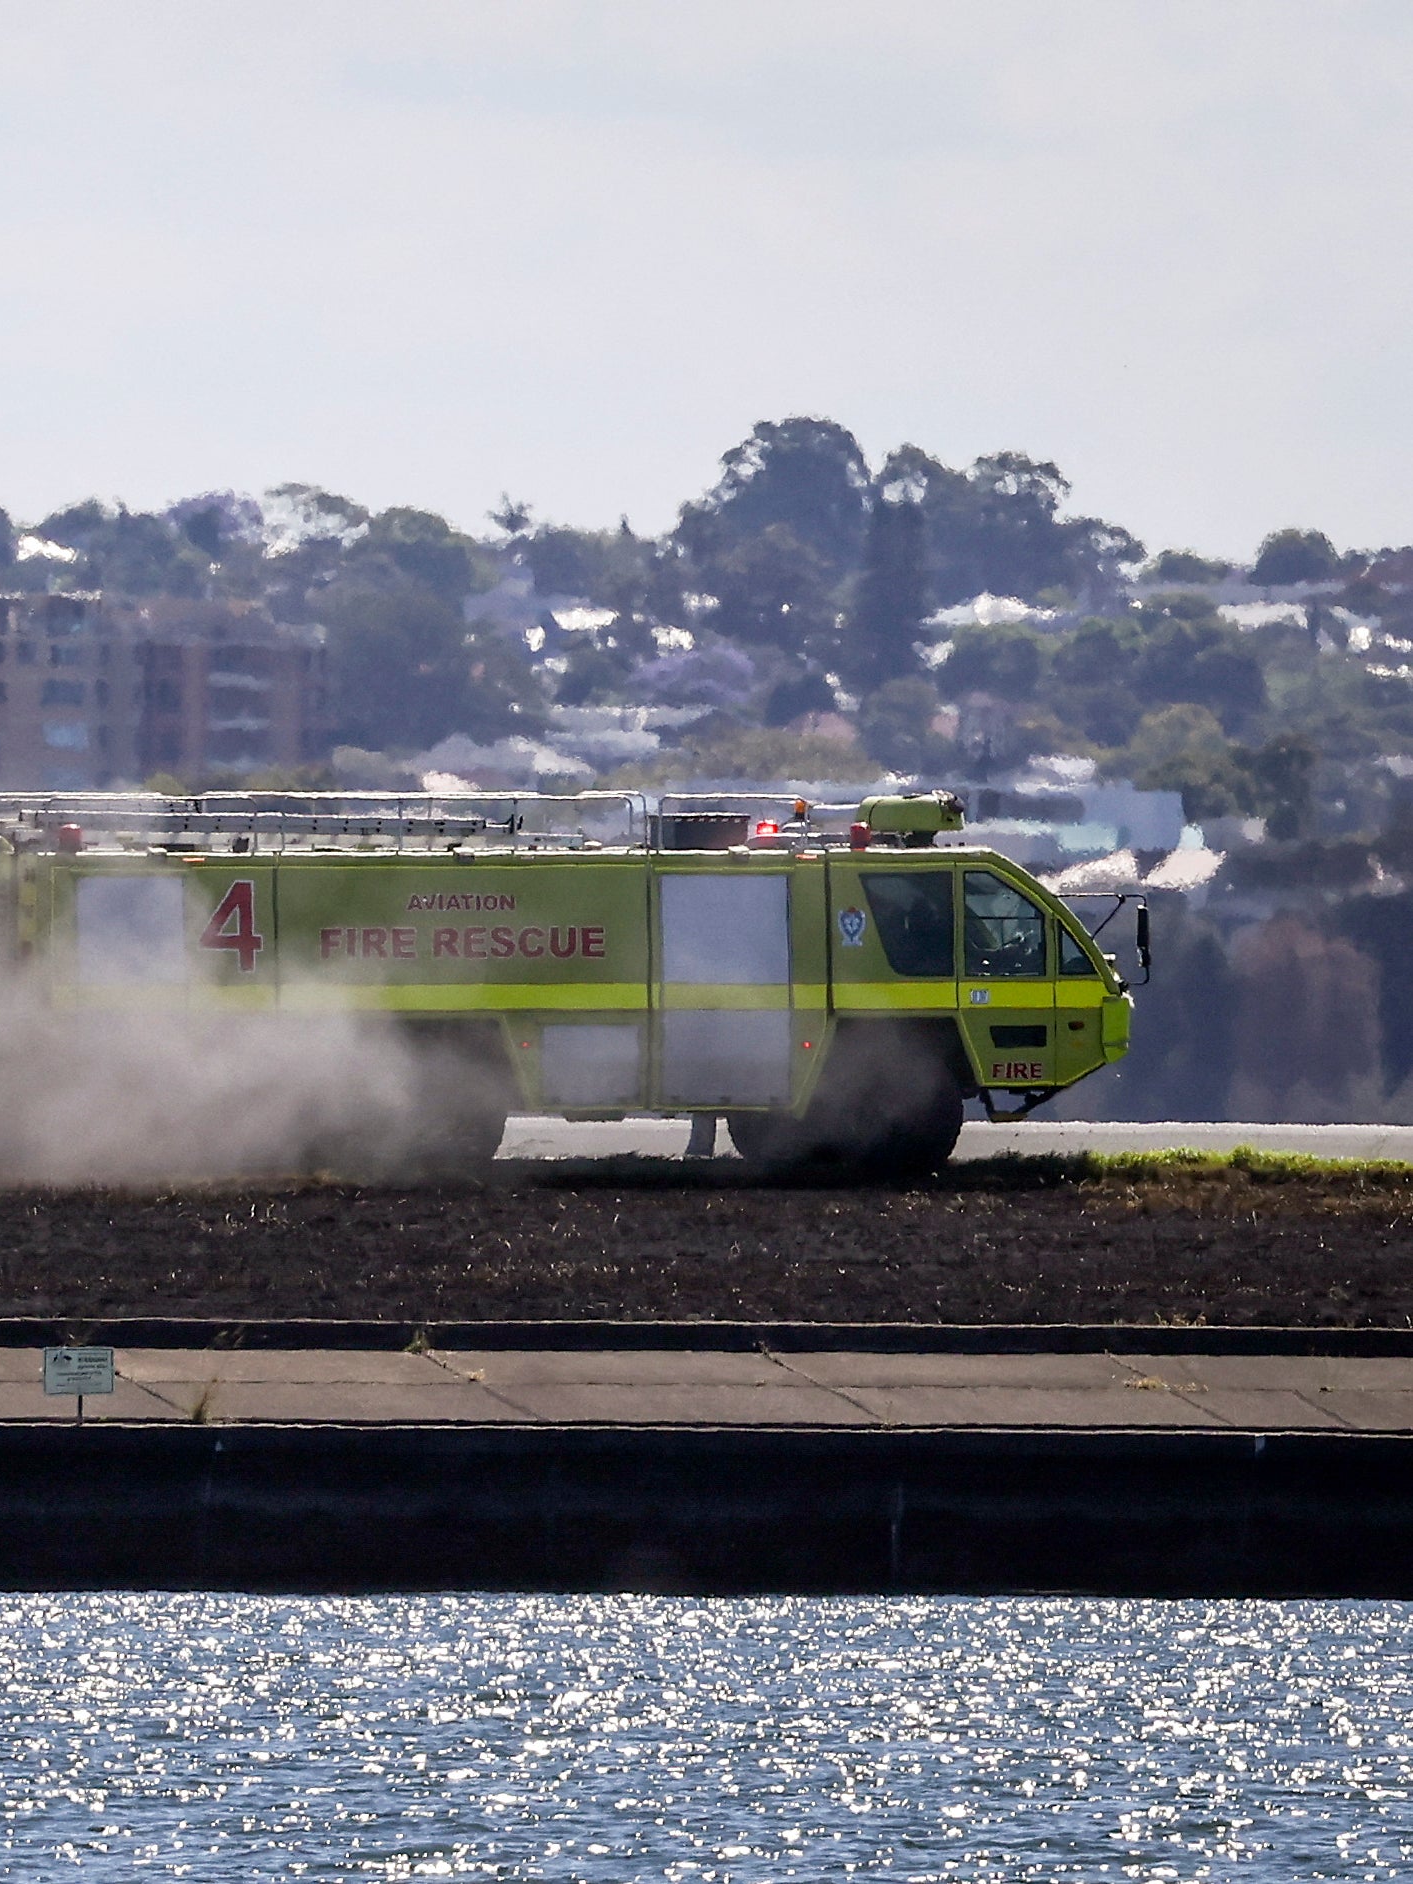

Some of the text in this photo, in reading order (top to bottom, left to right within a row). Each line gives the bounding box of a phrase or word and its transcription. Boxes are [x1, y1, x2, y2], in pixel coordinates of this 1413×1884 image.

[406, 893, 516, 912] AVIATION
[199, 880, 263, 973] 4
[320, 926, 606, 960] FIRE RESCUE
[991, 1062, 1043, 1079] FIRE
